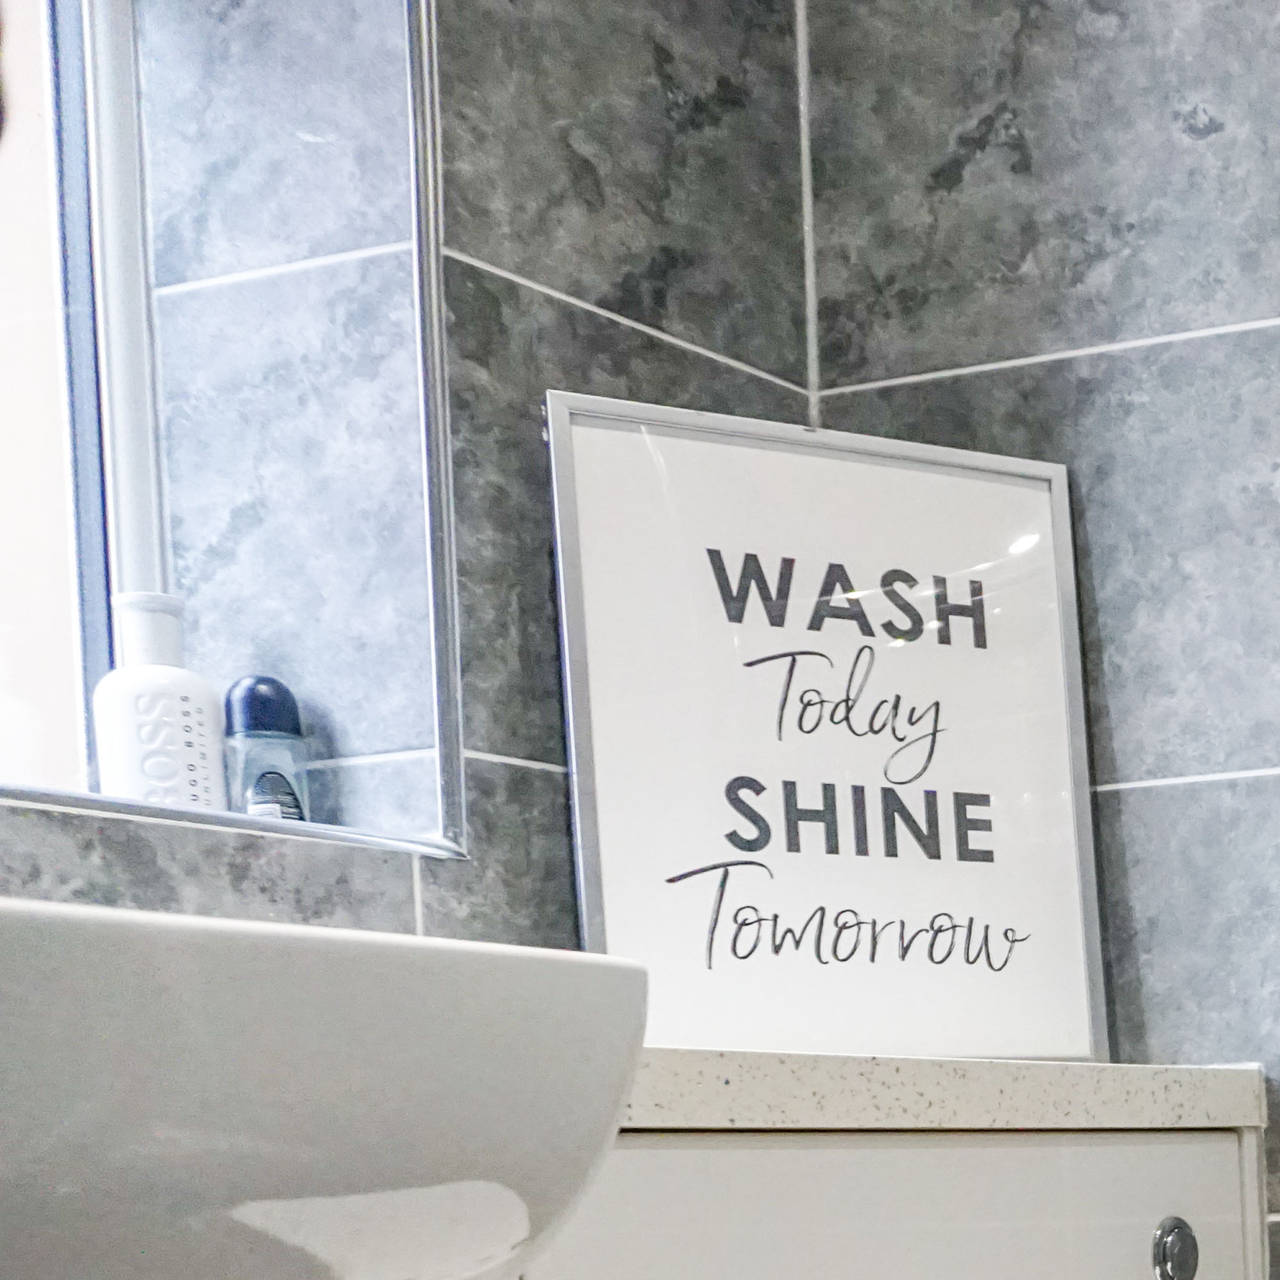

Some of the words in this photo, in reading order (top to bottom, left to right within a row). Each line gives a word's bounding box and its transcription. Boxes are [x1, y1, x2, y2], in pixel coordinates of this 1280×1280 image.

[705, 547, 989, 651] WASH
[179, 694, 195, 749] BOSS
[742, 644, 948, 786] Today
[186, 762, 200, 803] UGO
[723, 774, 996, 864] SHINE
[664, 859, 1032, 972] Tomorrow
